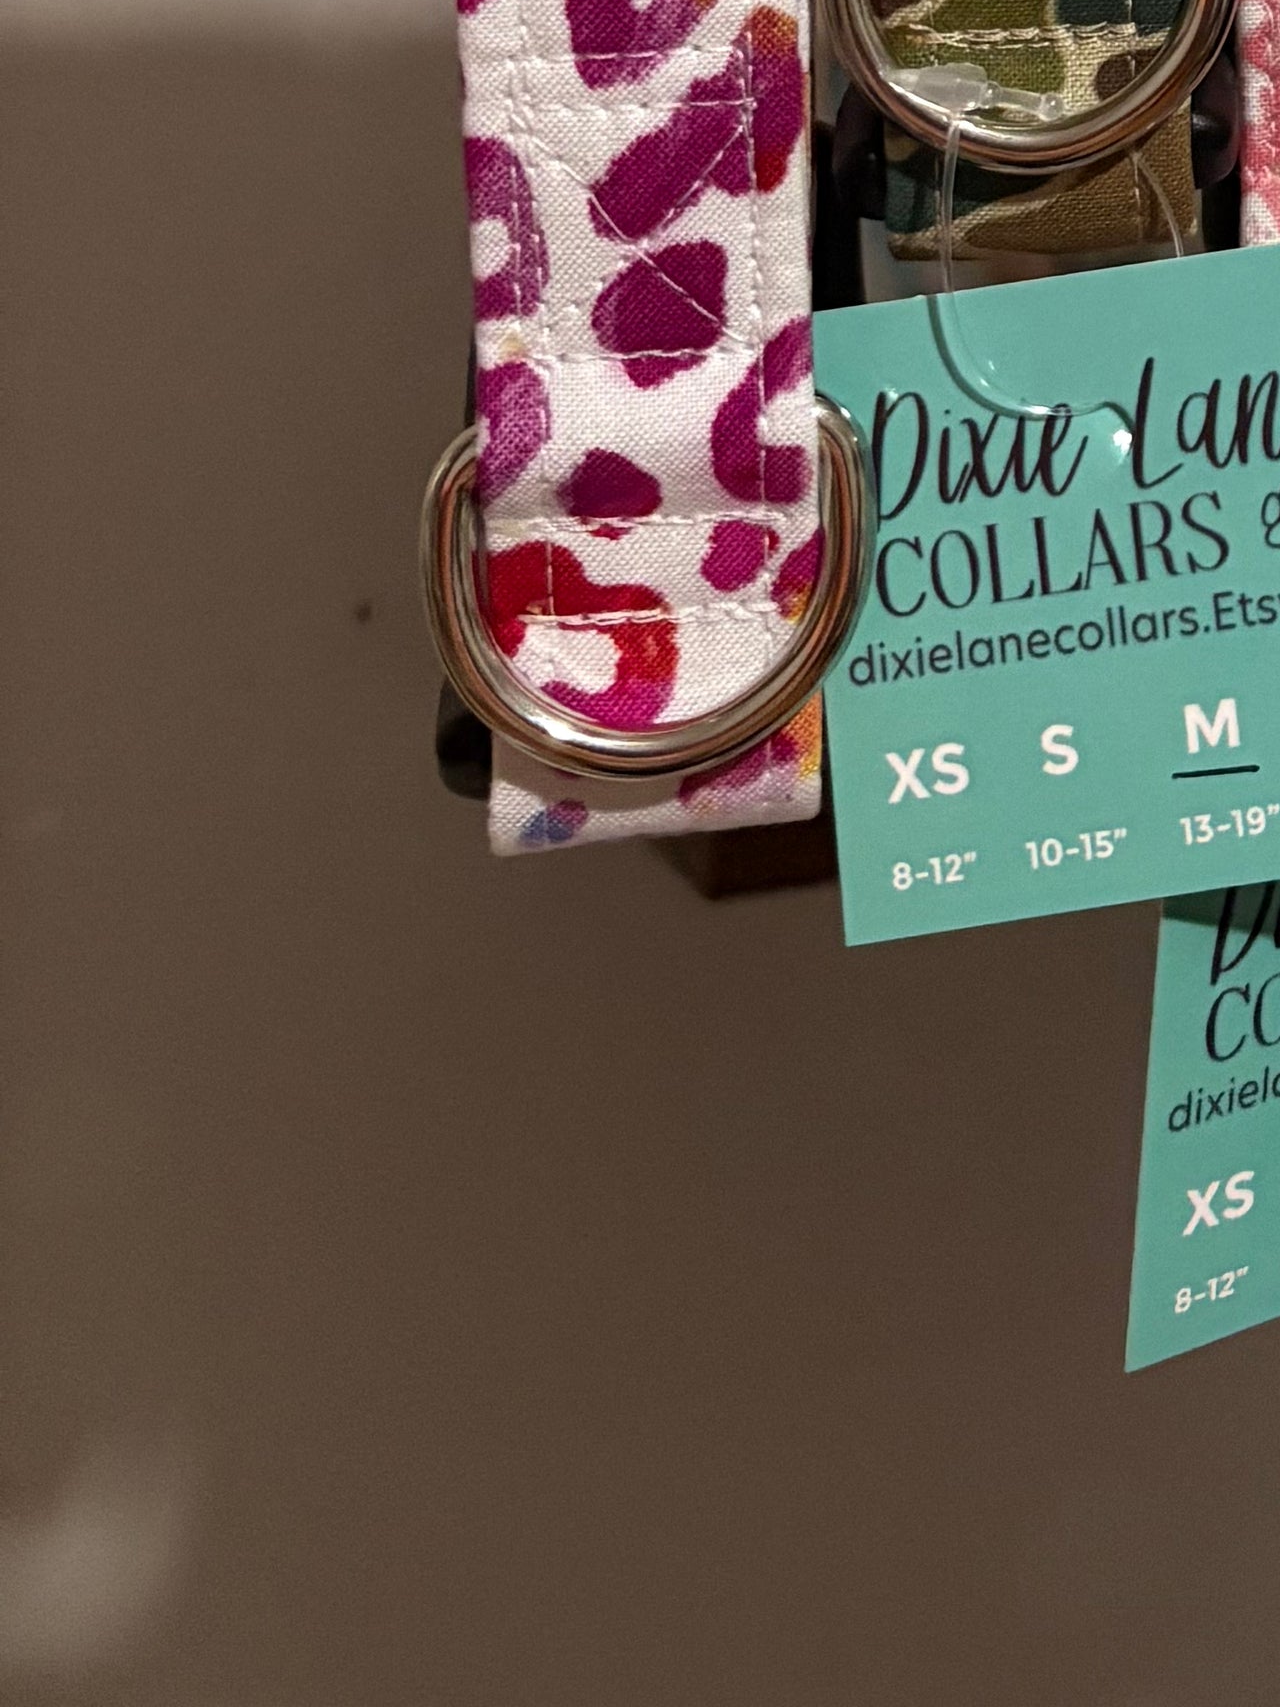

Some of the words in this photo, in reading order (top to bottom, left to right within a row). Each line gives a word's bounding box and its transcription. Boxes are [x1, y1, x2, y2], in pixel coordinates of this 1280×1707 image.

[872, 390, 1088, 524] Dixie
[876, 491, 1230, 617] COLLARS
[886, 743, 970, 803] XS
[1040, 724, 1079, 775] S
[1183, 697, 1242, 754] M
[1183, 1170, 1254, 1236] XS
